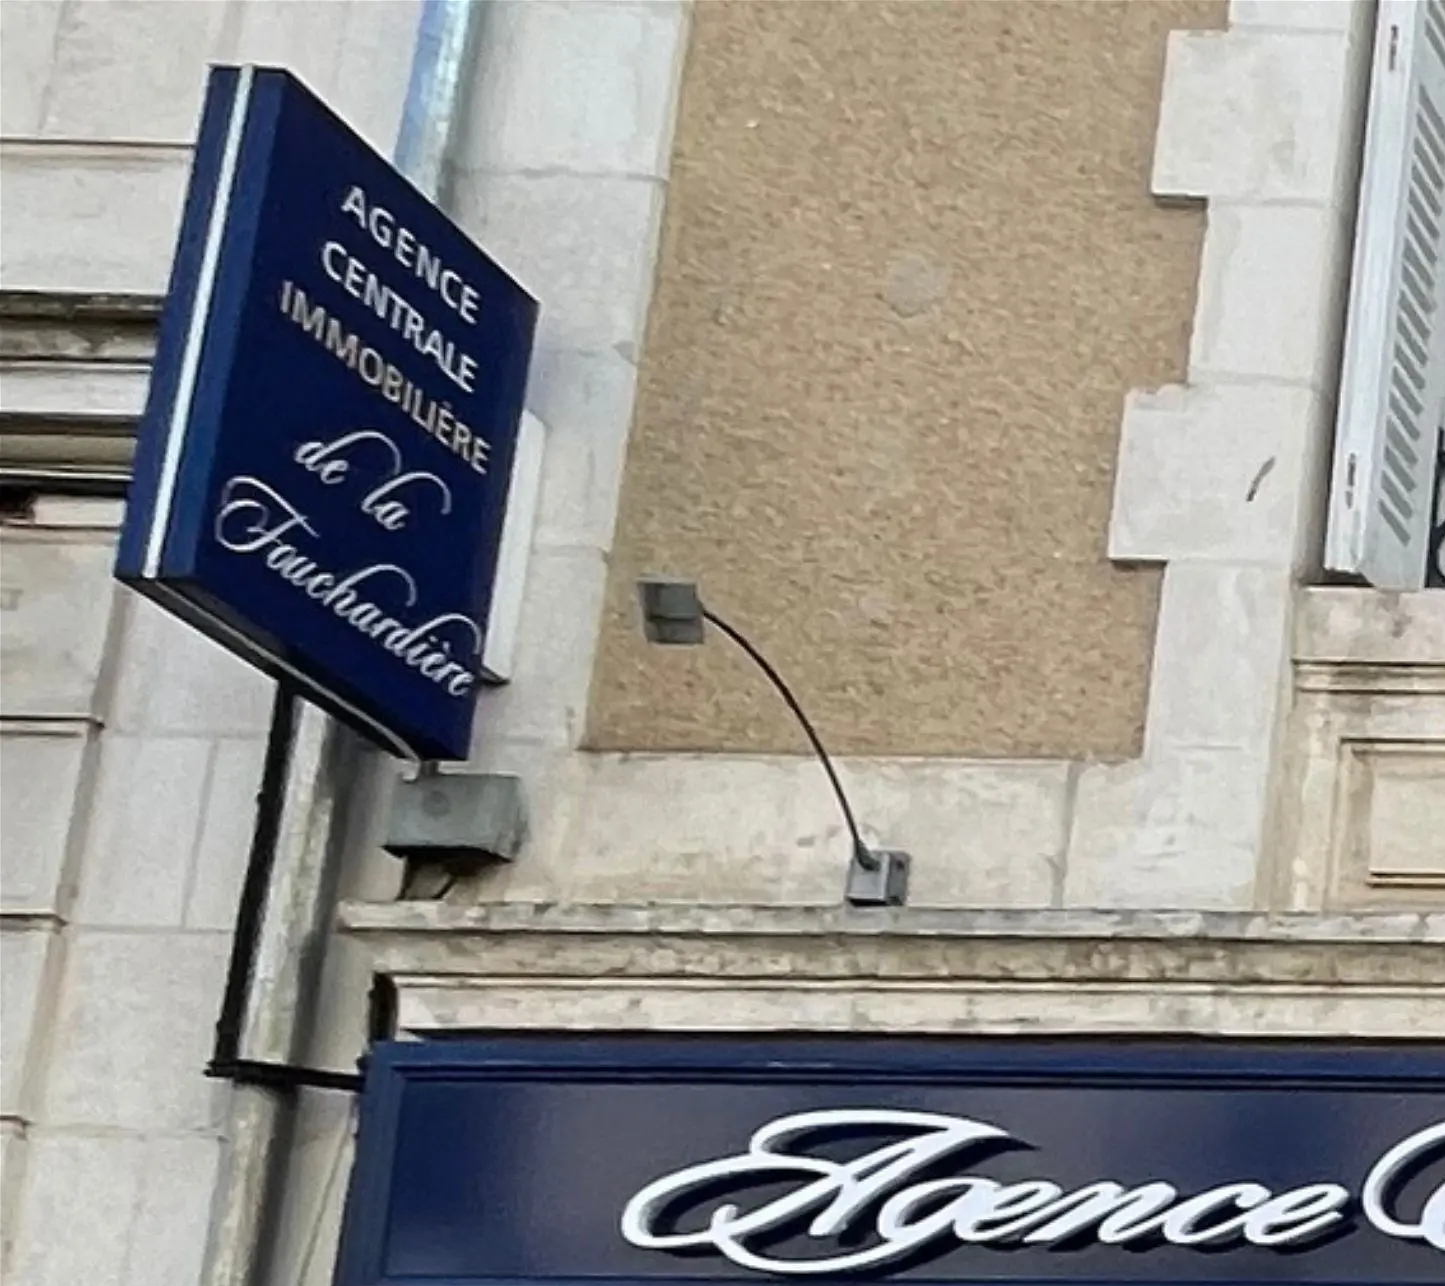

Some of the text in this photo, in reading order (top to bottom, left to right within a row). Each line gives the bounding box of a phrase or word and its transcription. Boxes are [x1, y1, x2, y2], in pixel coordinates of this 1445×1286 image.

[321, 241, 479, 393] CENTRALE
[341, 185, 480, 325] AGENCE
[280, 280, 492, 475] IMMOBILIÈRE
[294, 430, 451, 530] de la
[215, 476, 482, 695] Fouchardière
[621, 1108, 1349, 1273] Agence
